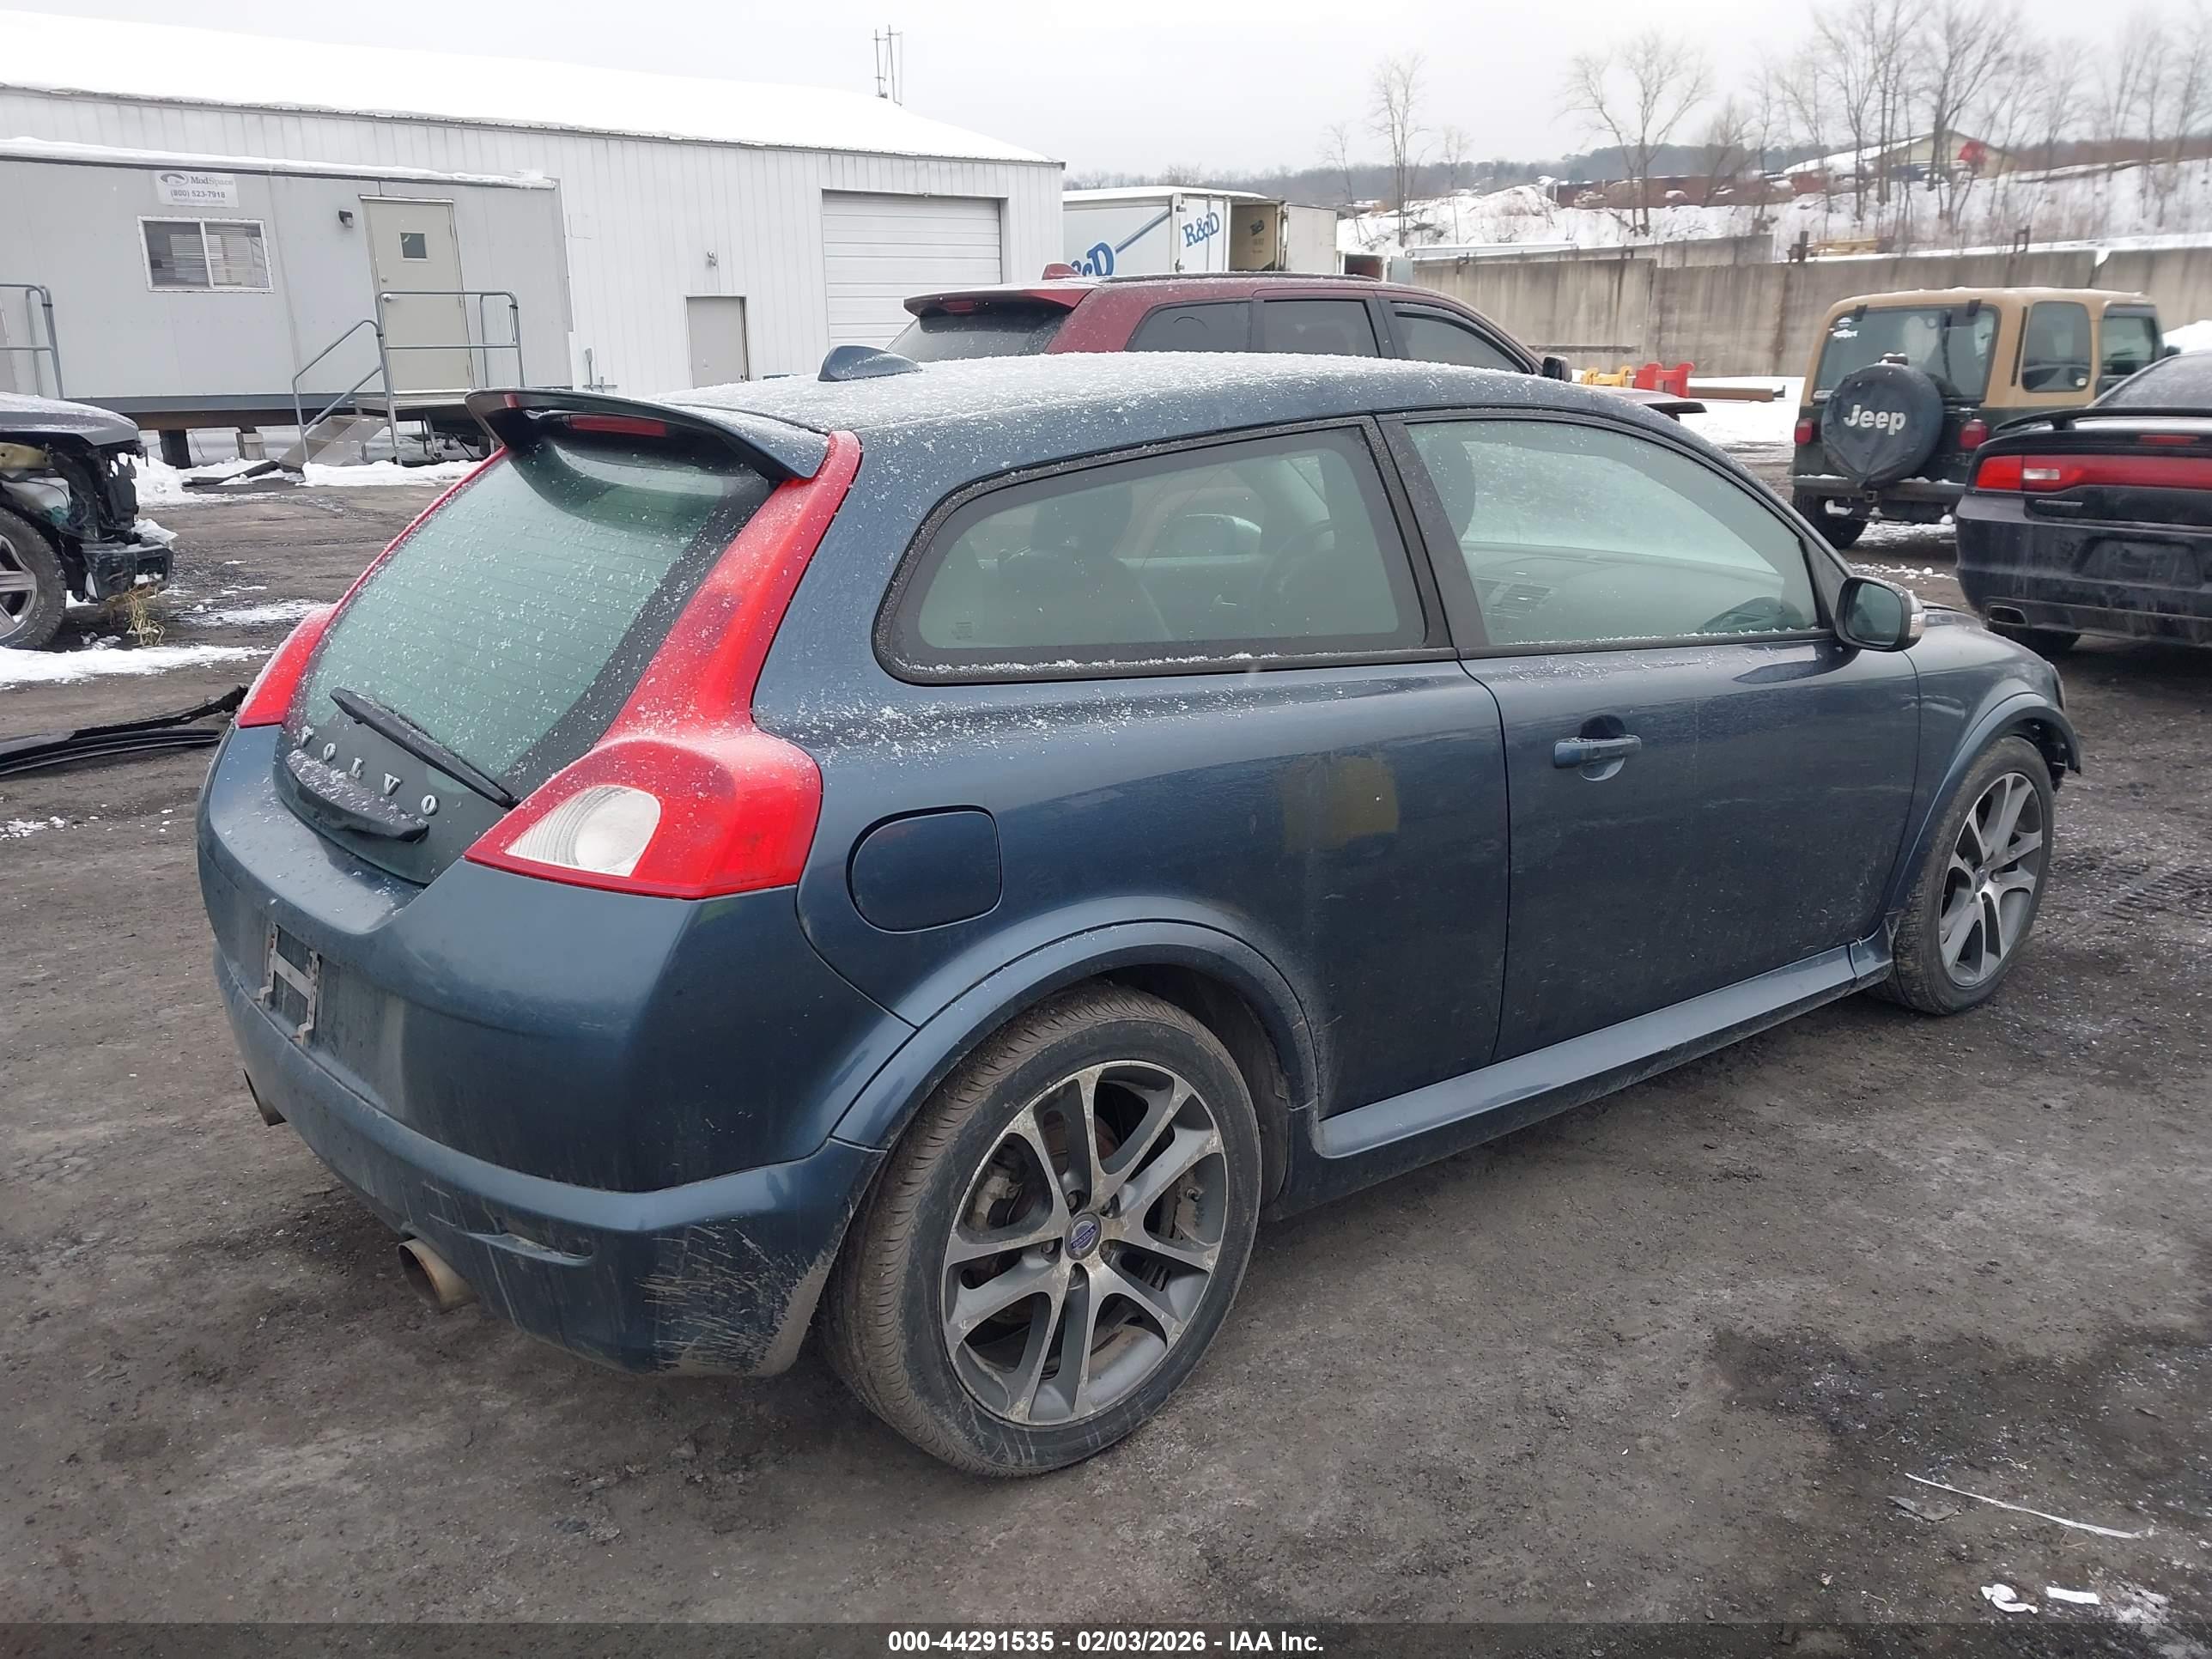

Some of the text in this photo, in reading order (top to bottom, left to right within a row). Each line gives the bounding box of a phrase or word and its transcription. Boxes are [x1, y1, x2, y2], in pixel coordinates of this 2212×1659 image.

[170, 190, 189, 198] (800)
[1182, 212, 1219, 247] R&D
[1843, 404, 1906, 435] Jeep
[301, 726, 439, 816] VOLVO
